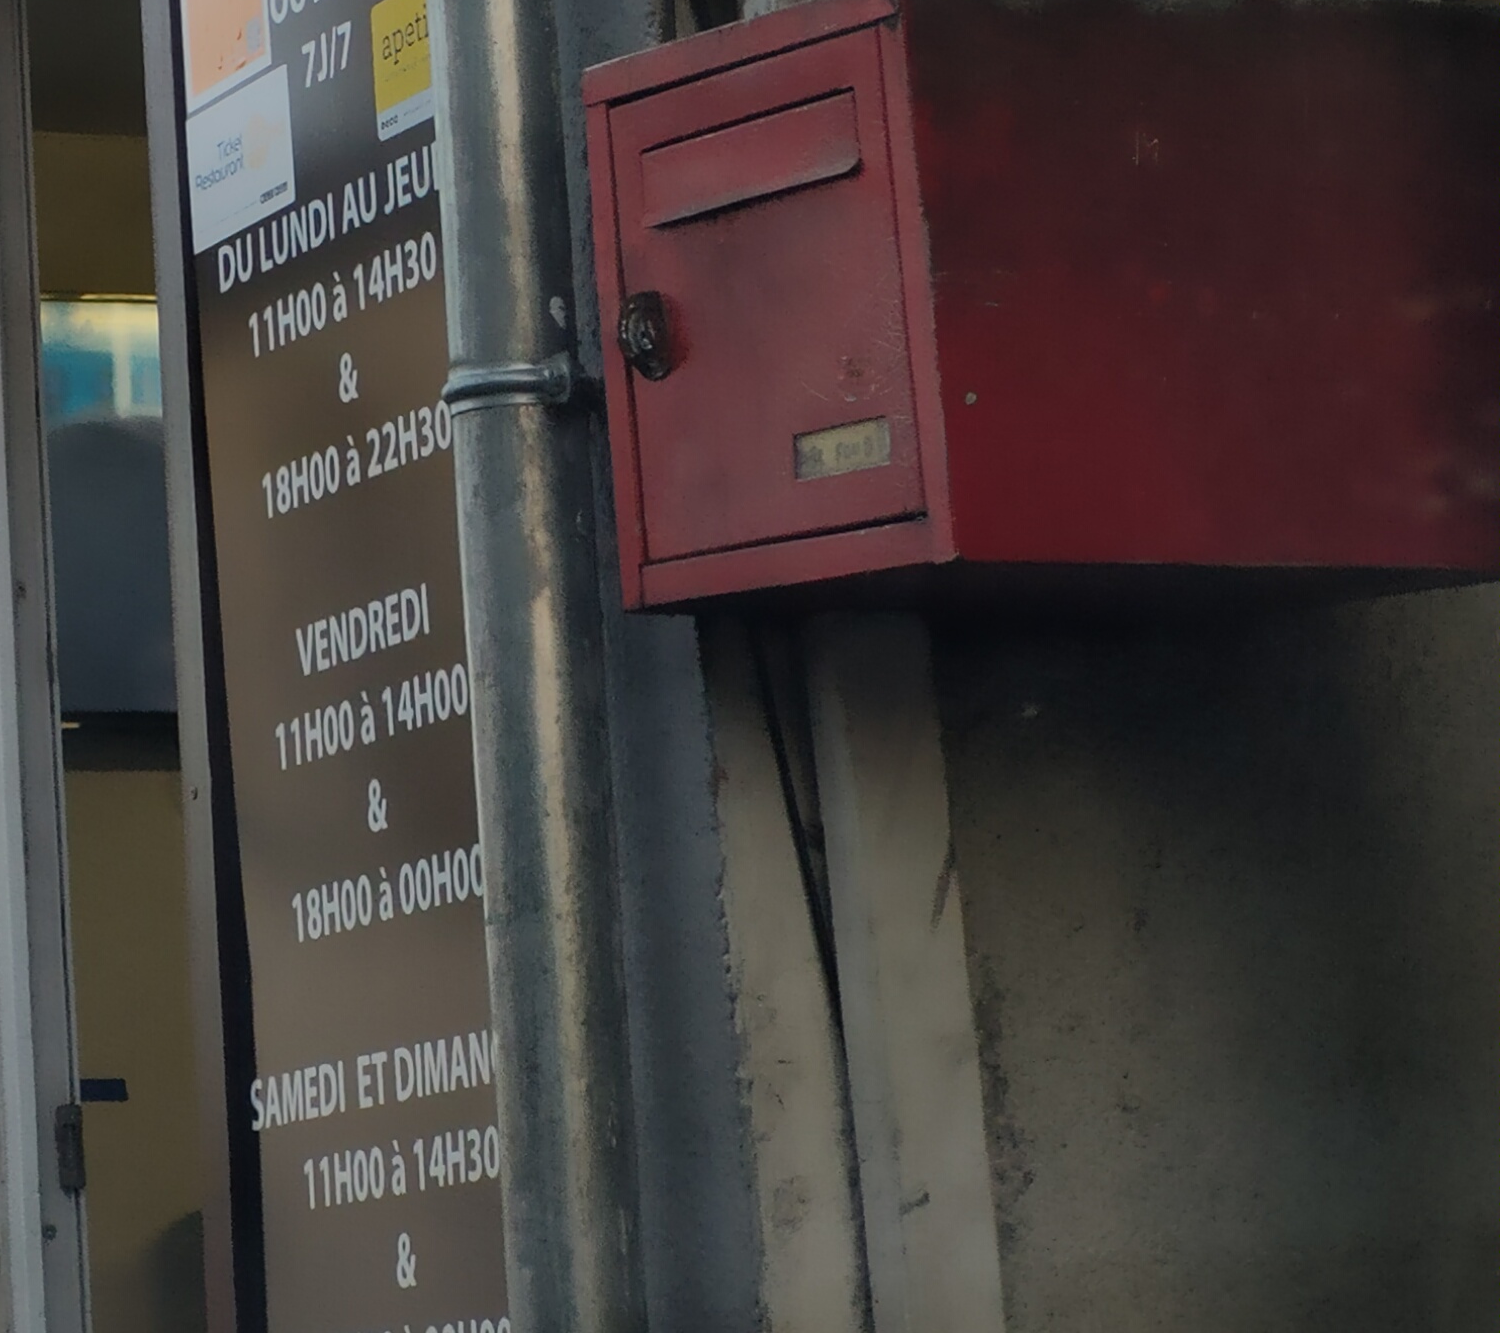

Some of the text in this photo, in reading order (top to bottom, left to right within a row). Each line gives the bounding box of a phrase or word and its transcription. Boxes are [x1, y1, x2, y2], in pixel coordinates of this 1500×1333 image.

[301, 21, 352, 88] 7J/7
[218, 142, 439, 294] DU LUNDI AU JEU
[248, 231, 437, 358] 11H00 à 14H30
[338, 351, 359, 403] &
[262, 399, 452, 519] 18H00 à 22H30
[296, 583, 430, 677] VENDREDI
[275, 663, 469, 771] 11H00 à 14H00
[367, 777, 388, 833] &
[292, 874, 372, 943] 18H00
[379, 866, 394, 922] à
[250, 1060, 346, 1131] SAMEDI
[357, 1051, 388, 1109] ET
[304, 1124, 499, 1210] 11H00 à 14H30
[396, 1233, 417, 1289] &
